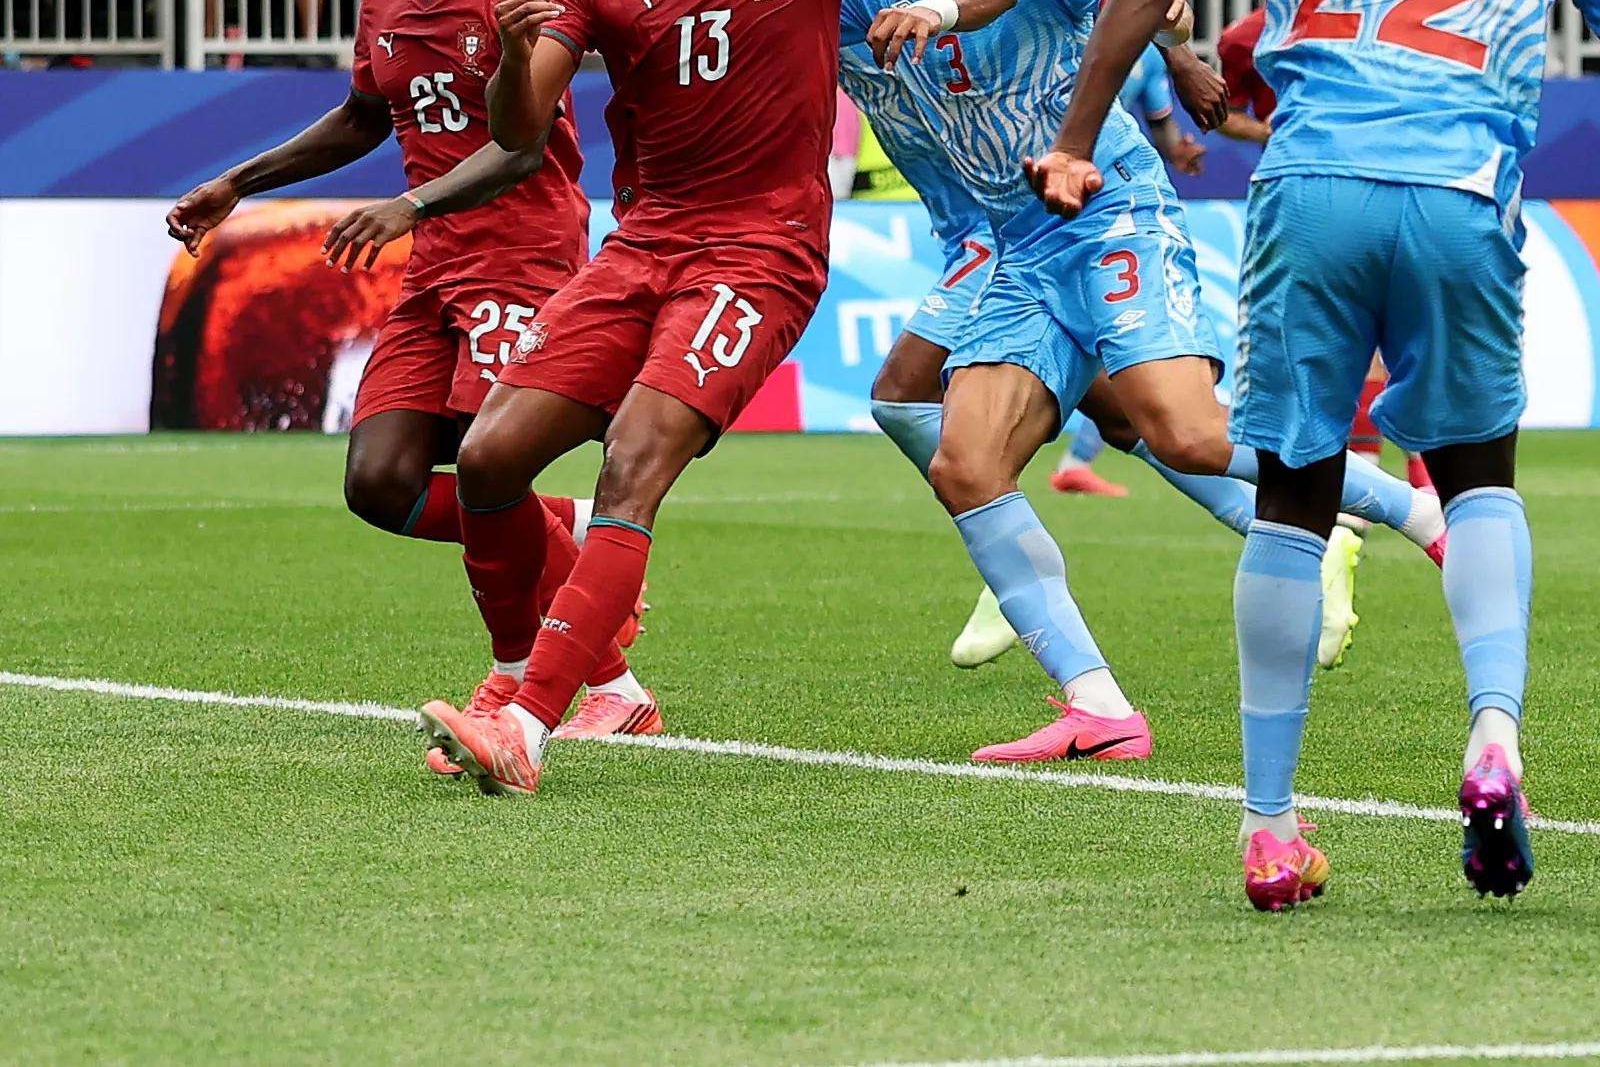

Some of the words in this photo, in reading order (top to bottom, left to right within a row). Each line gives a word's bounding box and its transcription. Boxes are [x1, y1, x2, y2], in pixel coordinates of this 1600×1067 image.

[674, 9, 731, 85] 13
[936, 34, 972, 94] 3
[410, 72, 469, 133] 25
[943, 240, 992, 288] 7
[1100, 250, 1140, 303] 3
[469, 300, 535, 365] 25
[690, 283, 763, 368] 13
